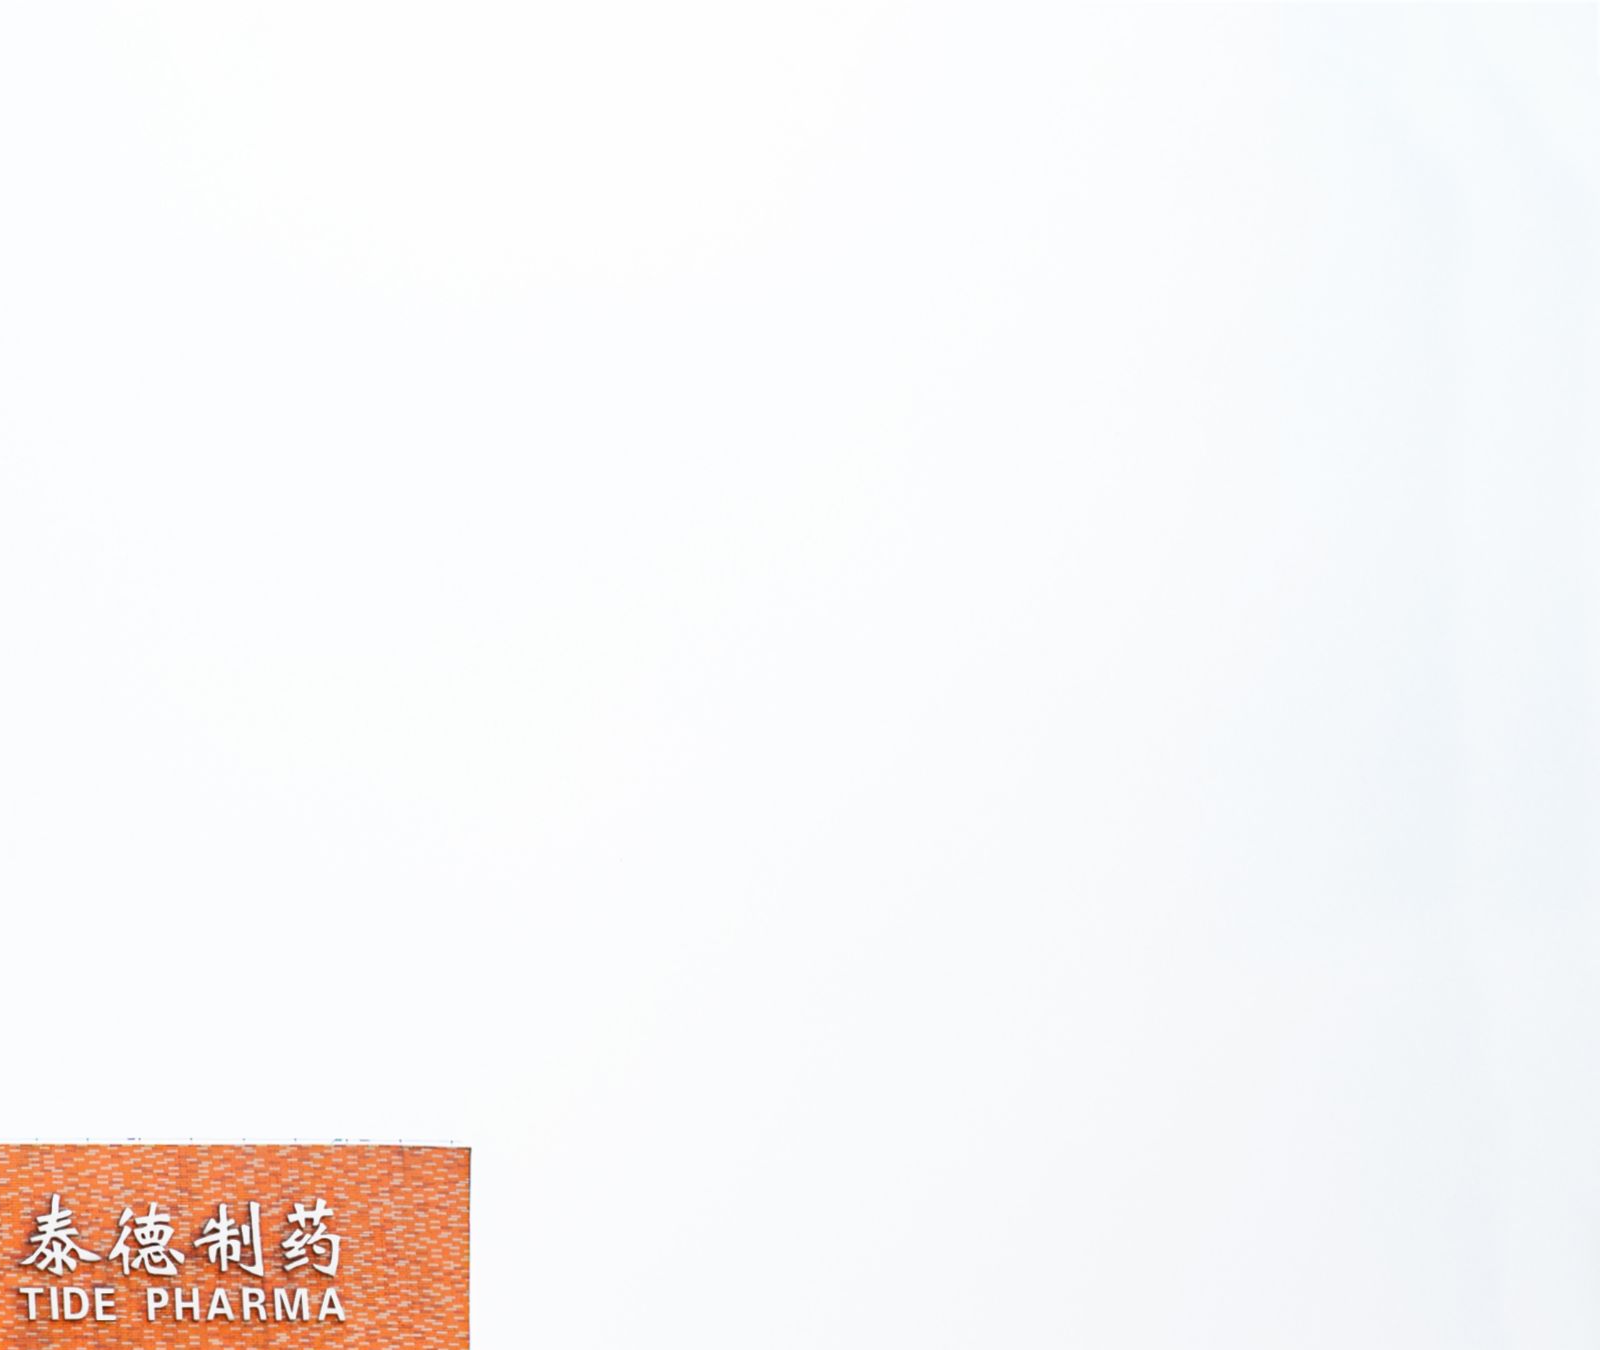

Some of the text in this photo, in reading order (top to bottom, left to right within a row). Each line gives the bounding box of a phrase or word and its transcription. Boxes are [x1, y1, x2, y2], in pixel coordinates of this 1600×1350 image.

[20, 1193, 341, 1277] 泰德制药
[19, 1286, 347, 1322] TIDE PHARMA
